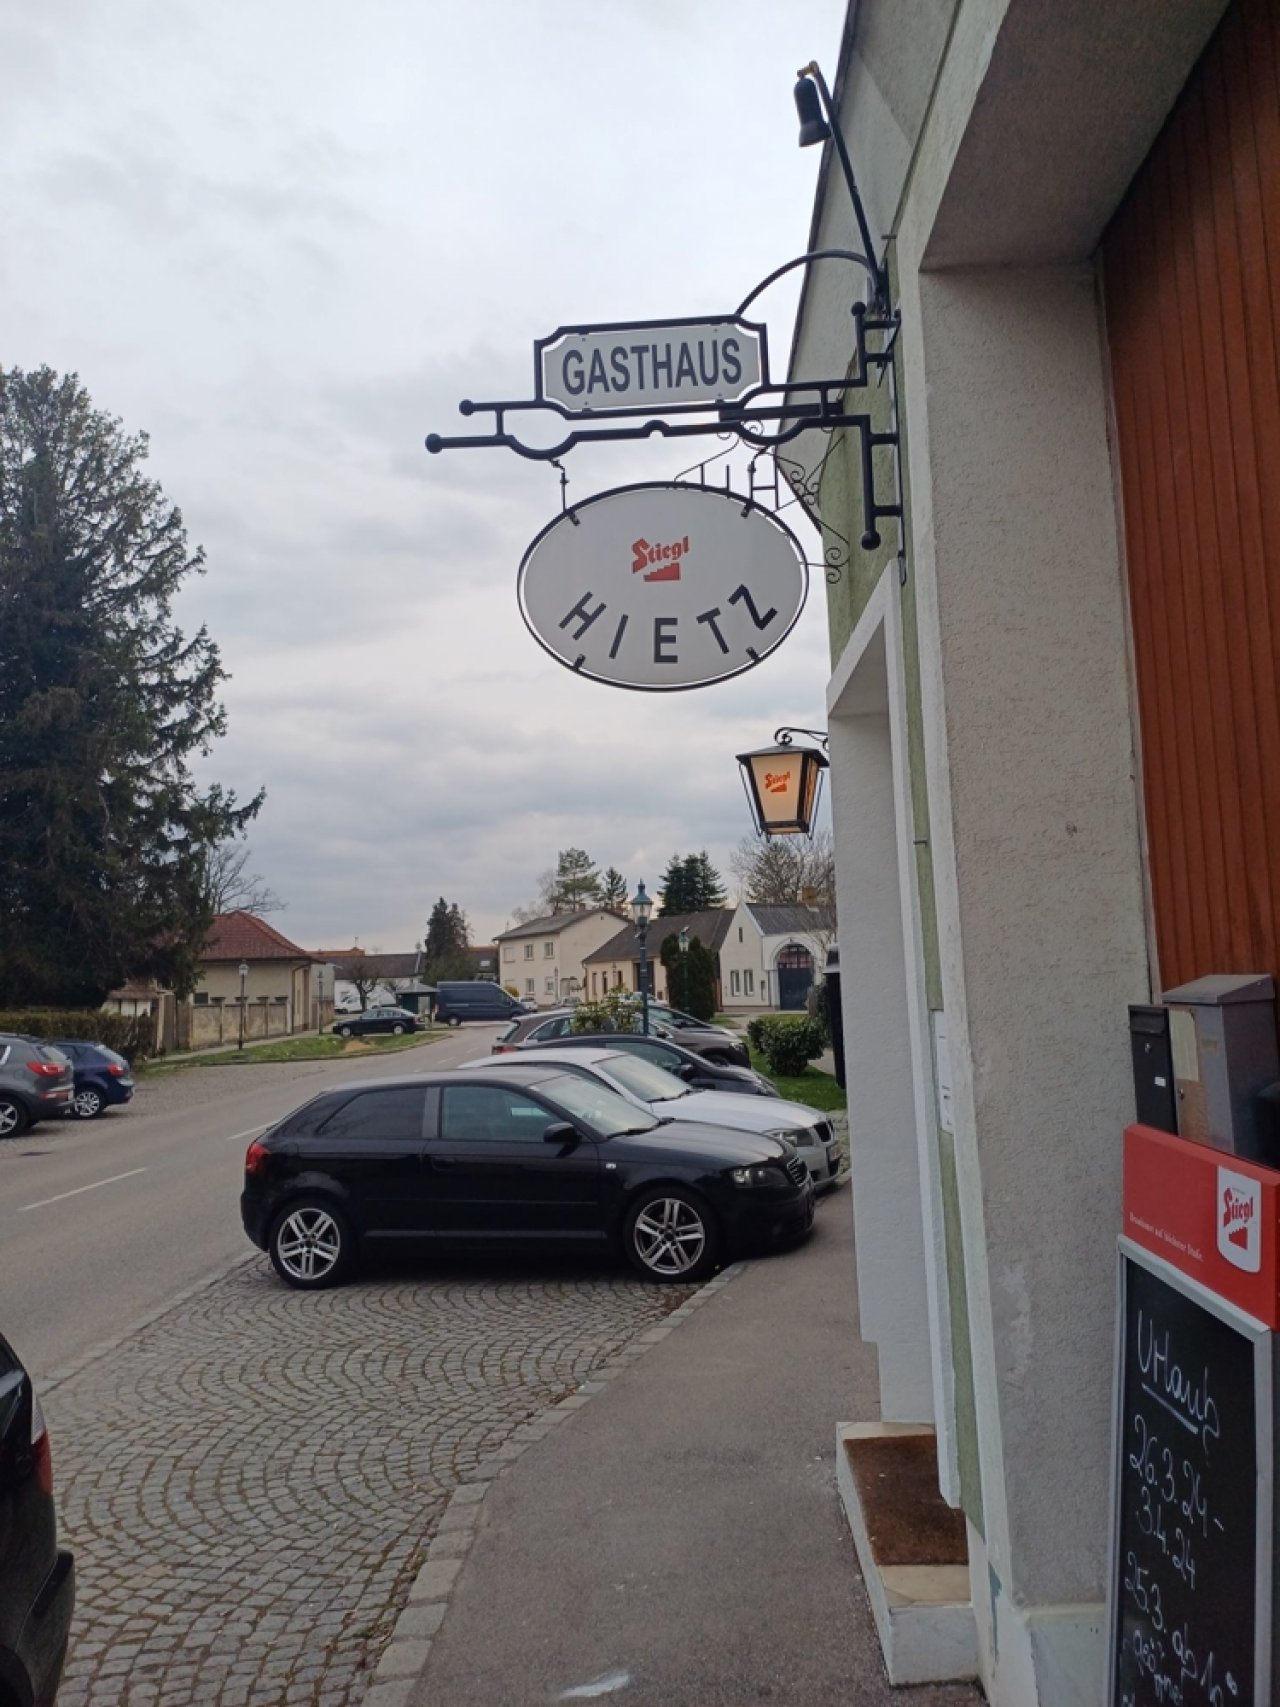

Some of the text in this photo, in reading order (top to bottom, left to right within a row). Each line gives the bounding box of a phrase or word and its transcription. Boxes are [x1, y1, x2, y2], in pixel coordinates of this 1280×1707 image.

[562, 337, 742, 395] GASTHAUS
[631, 535, 690, 575] Stiegl
[558, 583, 778, 664] HIETZ
[1223, 1187, 1254, 1227] Stiegl
[1137, 1309, 1220, 1452] Urlaub
